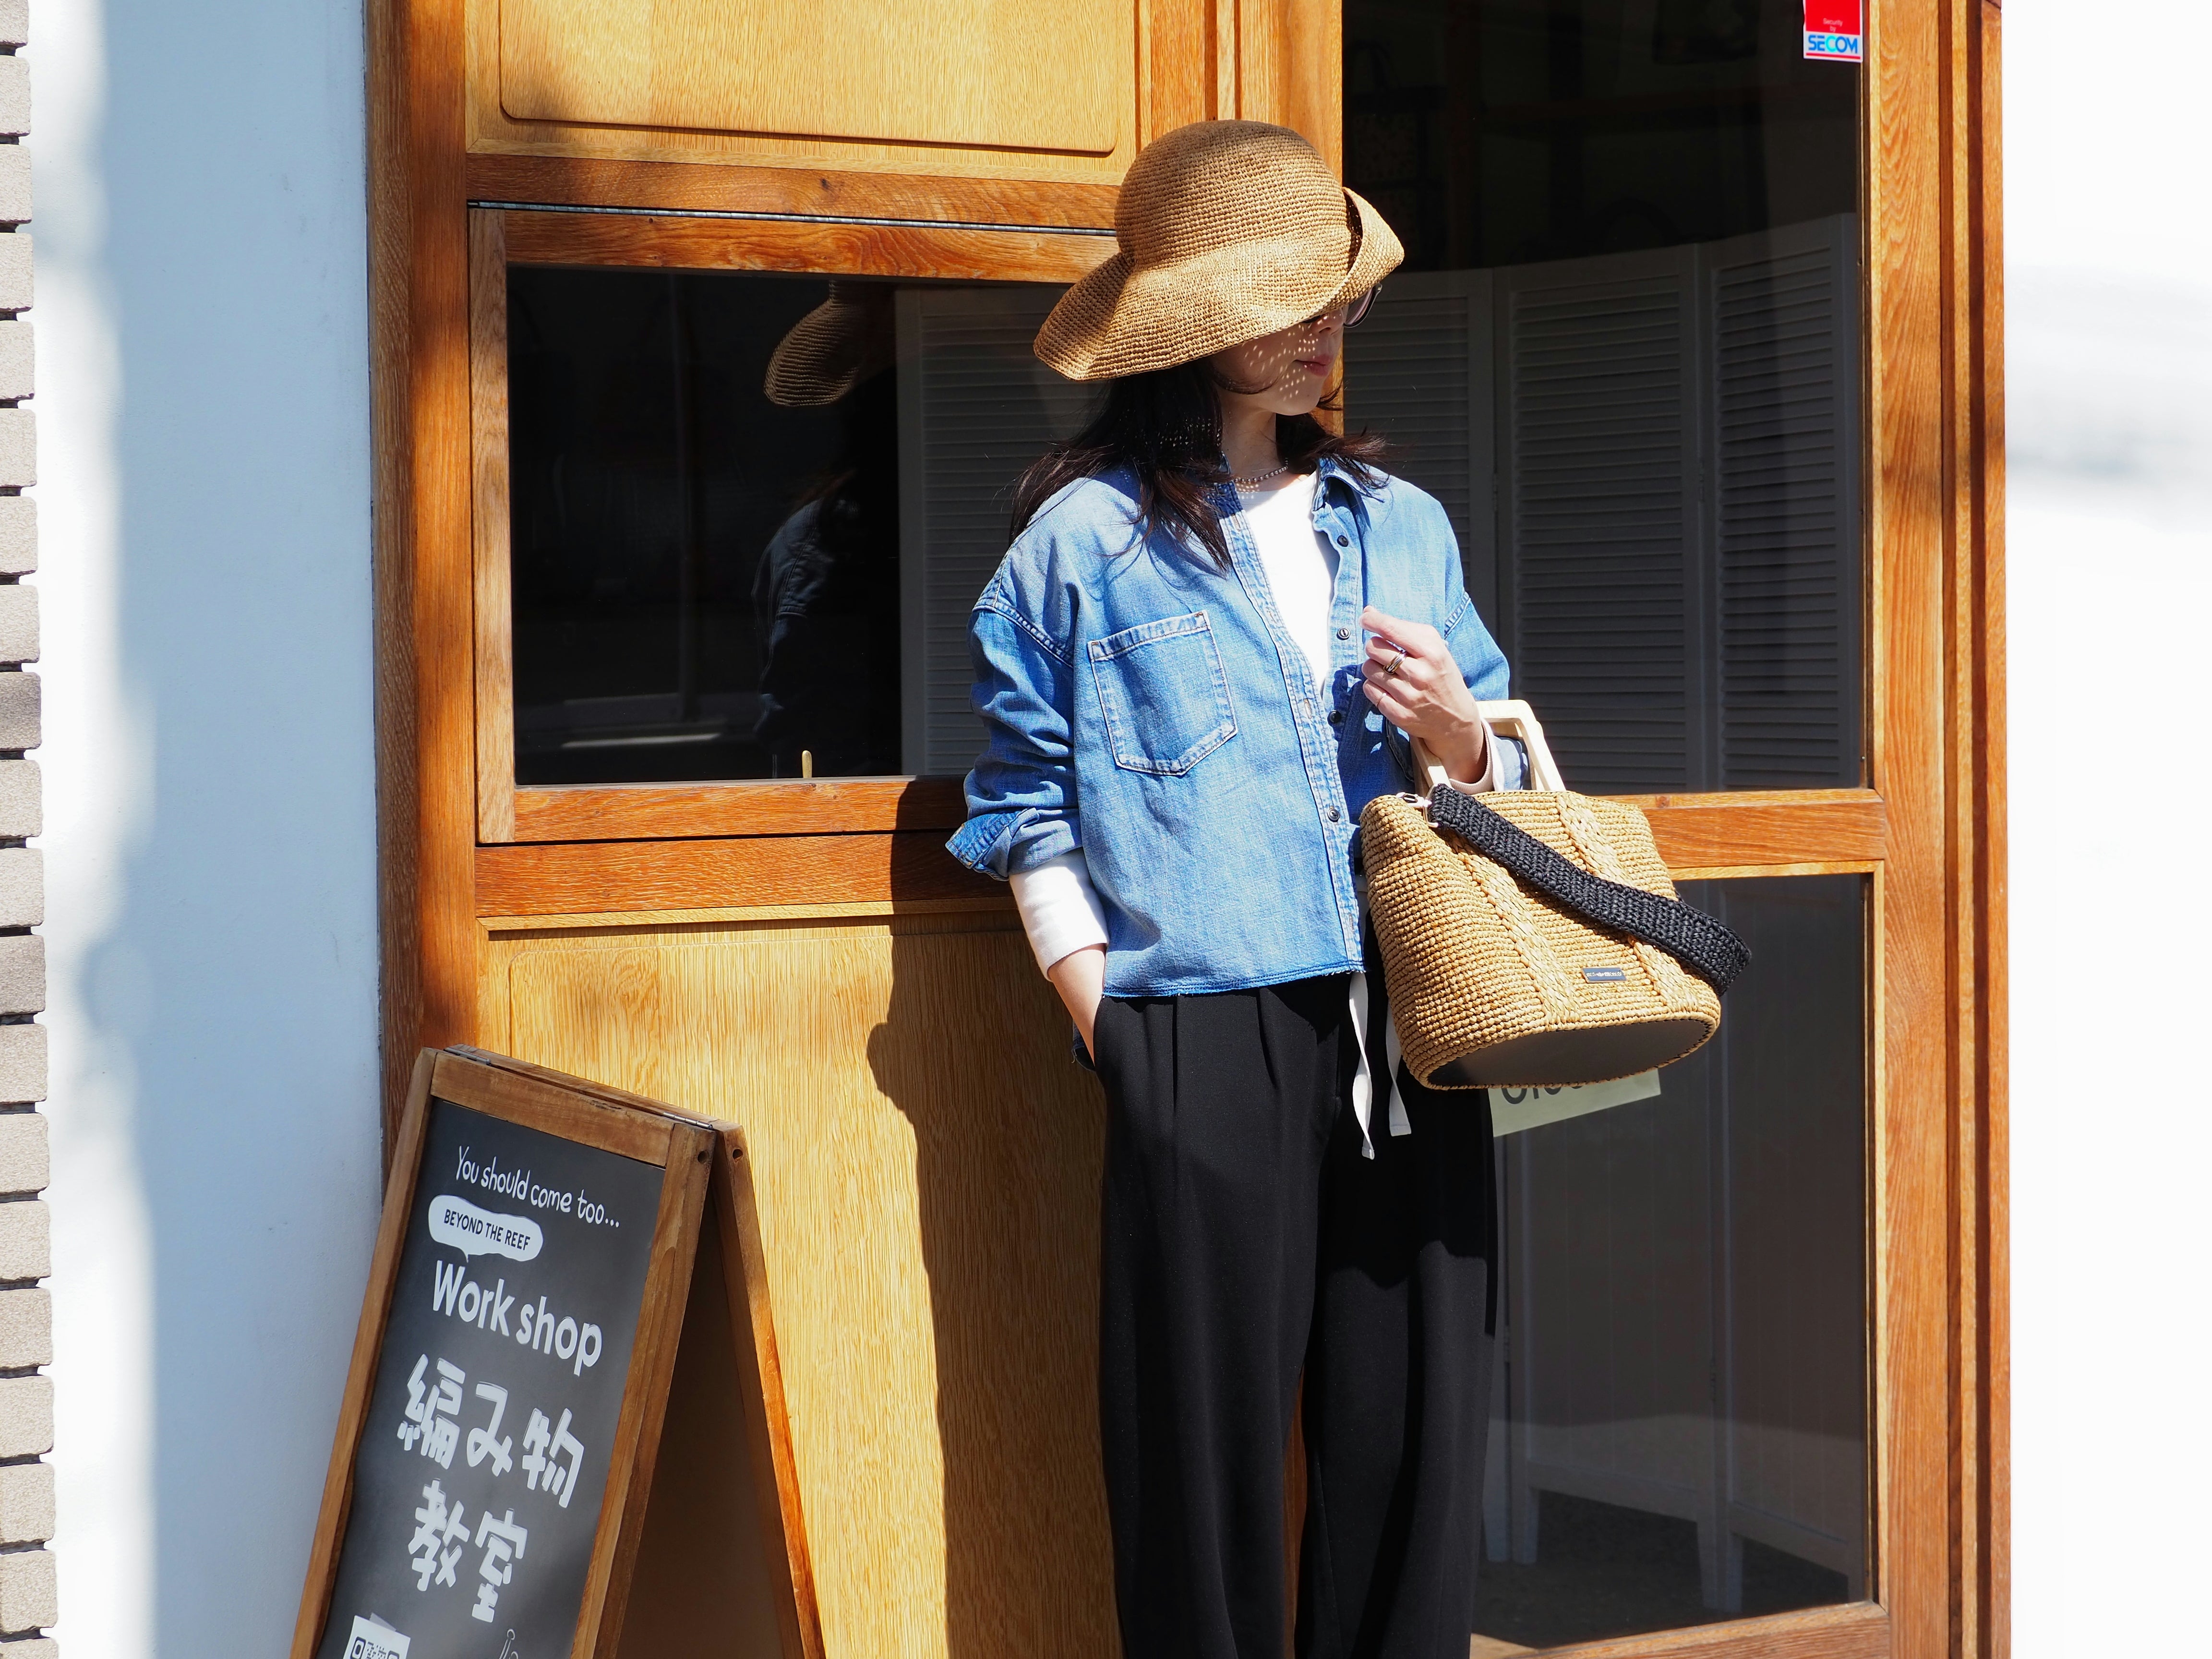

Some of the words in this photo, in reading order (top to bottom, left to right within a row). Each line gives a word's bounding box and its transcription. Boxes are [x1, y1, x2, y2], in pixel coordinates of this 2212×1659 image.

[1808, 35, 1858, 54] SECOM
[456, 1145, 479, 1184] You
[481, 1156, 530, 1200] should
[530, 1184, 573, 1213] come
[444, 1208, 483, 1236] BEYOND
[486, 1222, 504, 1243] THE
[505, 1230, 531, 1251] REEF
[433, 1260, 516, 1337] Work
[516, 1296, 602, 1377] shop
[397, 1353, 584, 1509] 編み物
[408, 1478, 528, 1623] 教室
